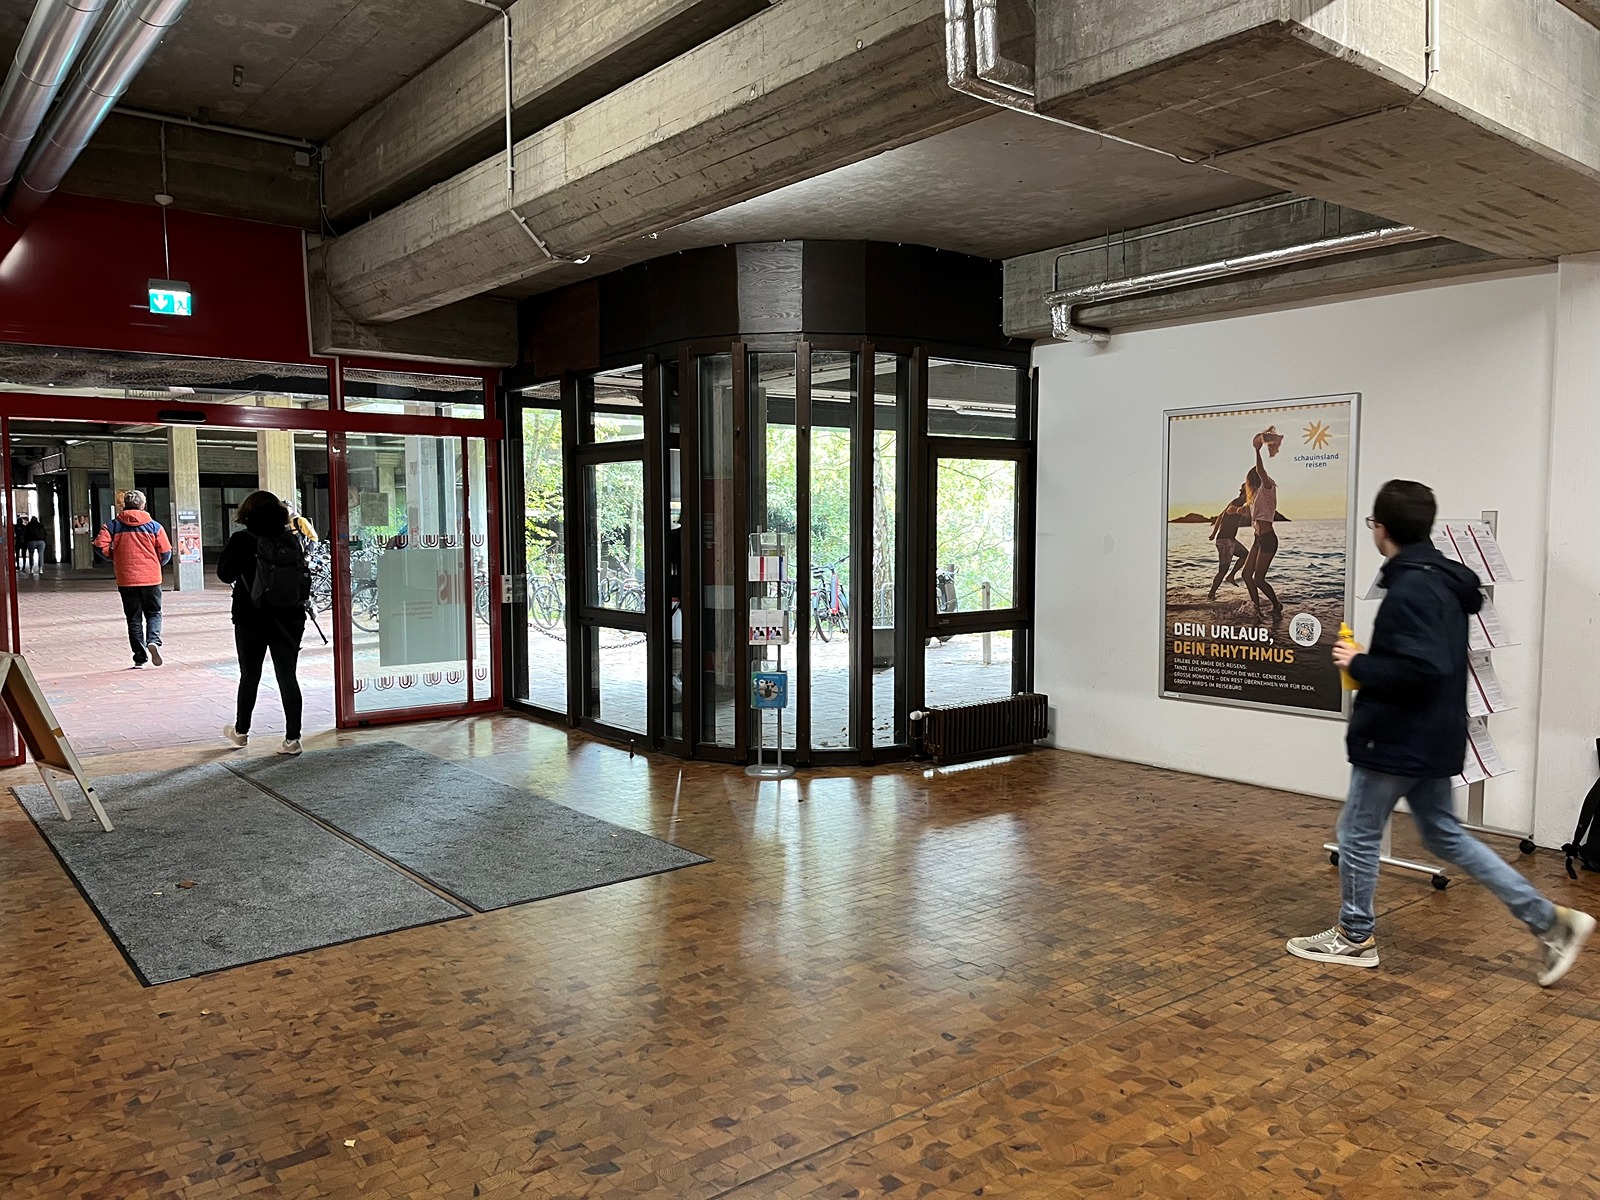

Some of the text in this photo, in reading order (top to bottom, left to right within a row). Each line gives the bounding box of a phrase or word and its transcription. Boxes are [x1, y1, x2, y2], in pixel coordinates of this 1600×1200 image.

[1294, 453, 1339, 461] schauinsland
[1174, 622, 1274, 645] DEIN URLAUB,
[1173, 640, 1295, 663] DEIN RHYTHMUS
[1174, 671, 1191, 679] GROSSE
[1192, 673, 1215, 681] MOMENTE
[1243, 678, 1278, 687] ÜBERNEHMEN
[1262, 673, 1287, 681] GENIESSE
